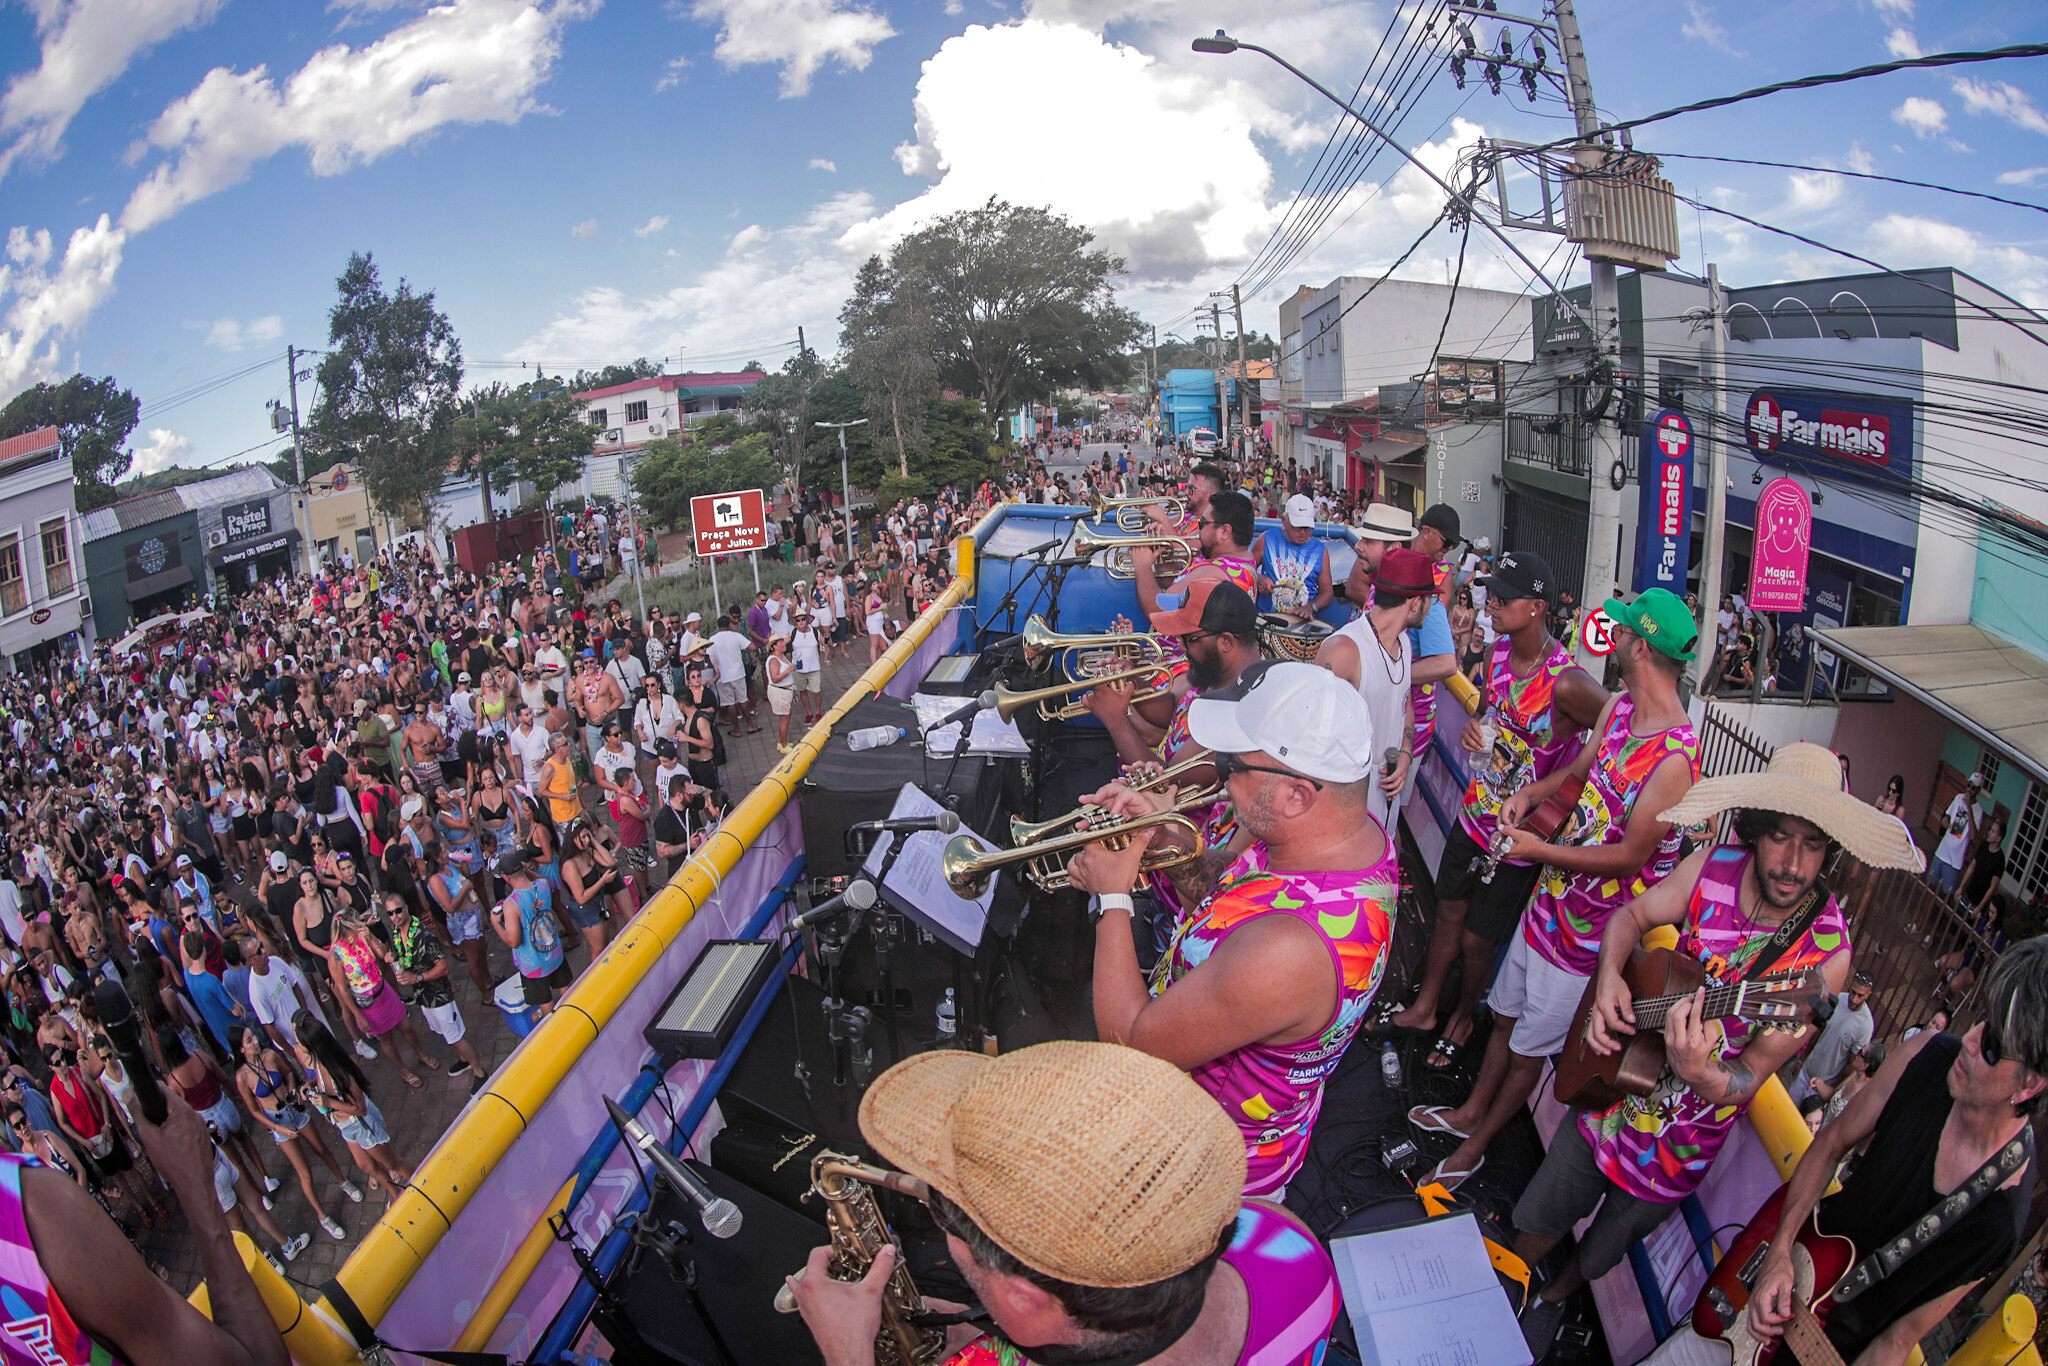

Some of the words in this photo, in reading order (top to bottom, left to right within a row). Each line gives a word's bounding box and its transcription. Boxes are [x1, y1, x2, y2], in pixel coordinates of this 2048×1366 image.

[1781, 410, 1886, 458] Farmais
[1436, 431, 1447, 504] IMOBILI
[227, 507, 266, 526] Pastel
[1657, 464, 1681, 582] Farmais
[228, 526, 241, 537] Da
[242, 520, 267, 533] Praça
[701, 531, 730, 541] Praça
[734, 527, 760, 536] Nove
[710, 542, 722, 550] de
[727, 538, 754, 549] Julho
[223, 552, 246, 563] Delivery
[1764, 565, 1796, 581] Magia
[1821, 589, 1835, 602] mais
[1816, 595, 1843, 613] desconto
[1293, 1065, 1325, 1078] FARMA
